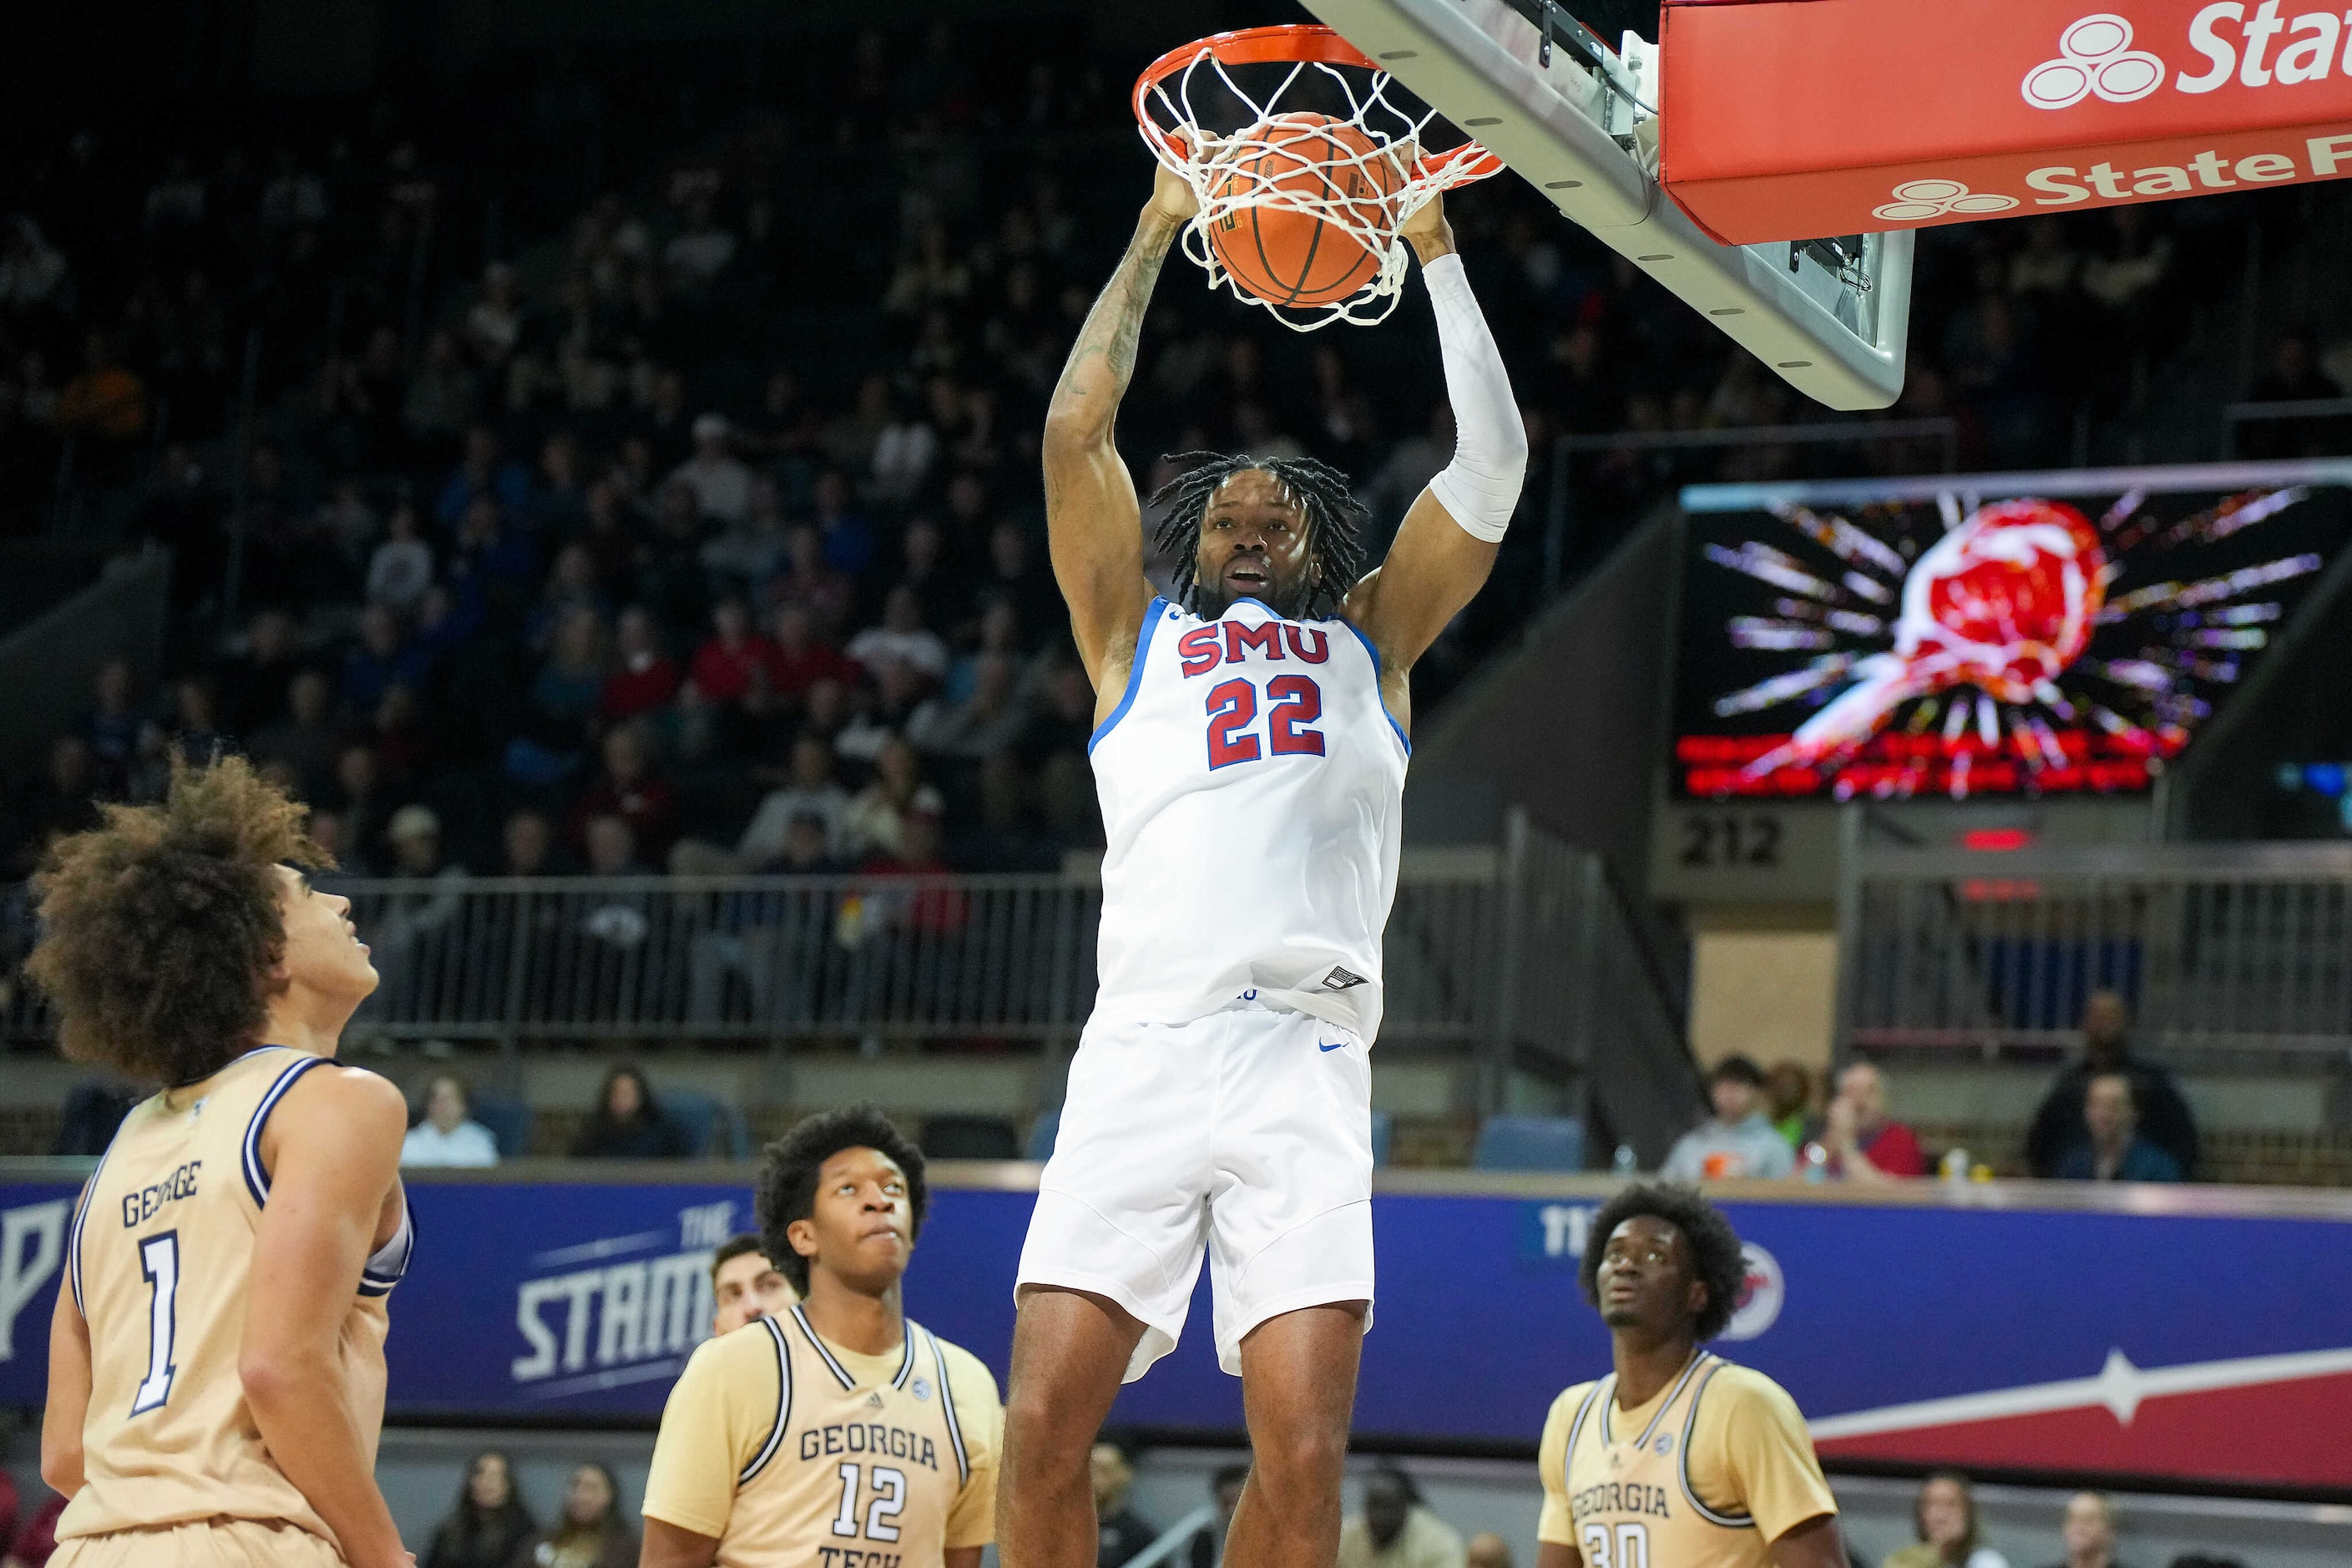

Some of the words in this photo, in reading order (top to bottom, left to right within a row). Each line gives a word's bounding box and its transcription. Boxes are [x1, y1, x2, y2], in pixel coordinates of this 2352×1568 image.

[2025, 150, 2296, 205] State
[1178, 620, 1329, 678] SMU
[1206, 674, 1326, 771] 22
[1680, 817, 1782, 863] 212
[122, 1159, 202, 1228] GEORGE
[679, 1201, 736, 1251] THE
[129, 1228, 179, 1419] 1
[511, 1252, 718, 1382] STAM
[800, 1423, 938, 1472] GEORGIA
[832, 1462, 907, 1543] 12
[1571, 1482, 1670, 1525] GEORGIA
[1583, 1521, 1650, 1568] 30
